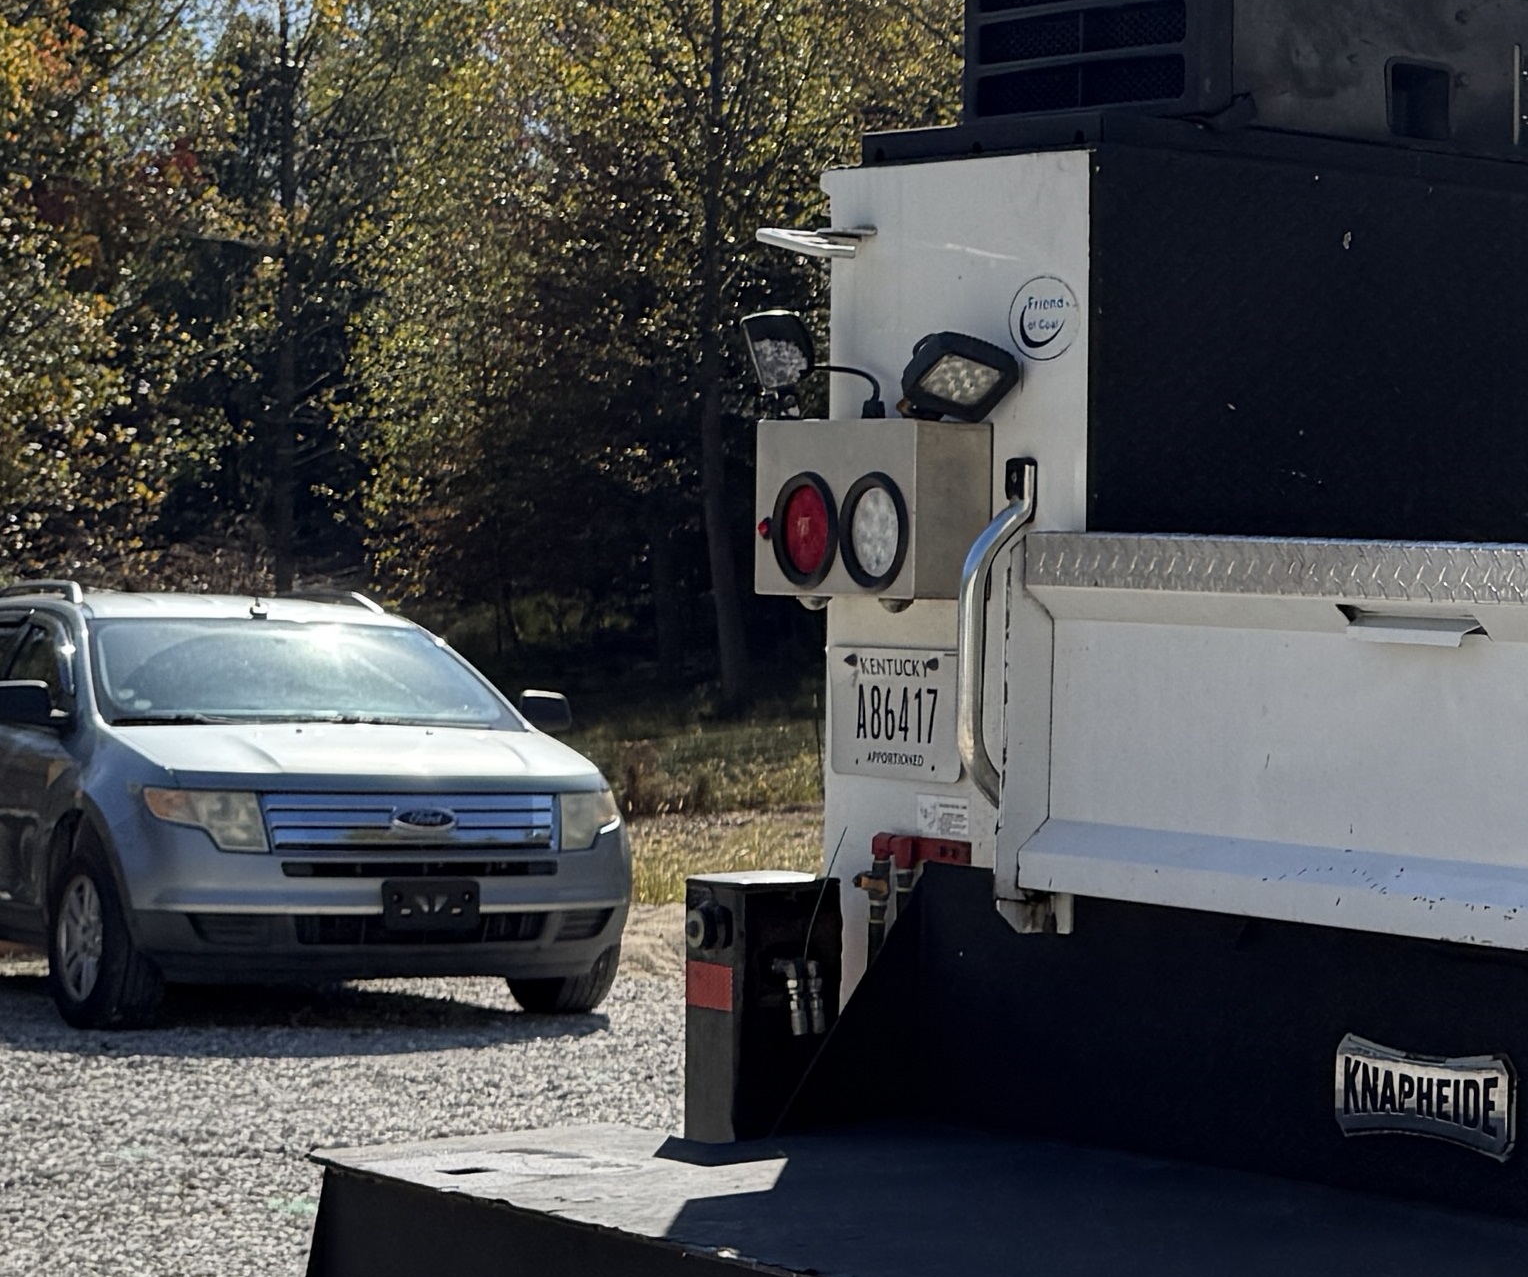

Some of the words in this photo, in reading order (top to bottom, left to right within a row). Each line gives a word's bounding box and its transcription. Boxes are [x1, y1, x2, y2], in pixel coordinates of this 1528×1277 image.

[1027, 296, 1070, 310] Friend
[860, 657, 929, 678] KENTUCKY
[856, 684, 938, 744] A86417
[867, 751, 924, 767] APPORTIONED
[1343, 1056, 1499, 1139] KNAPHEIDE
